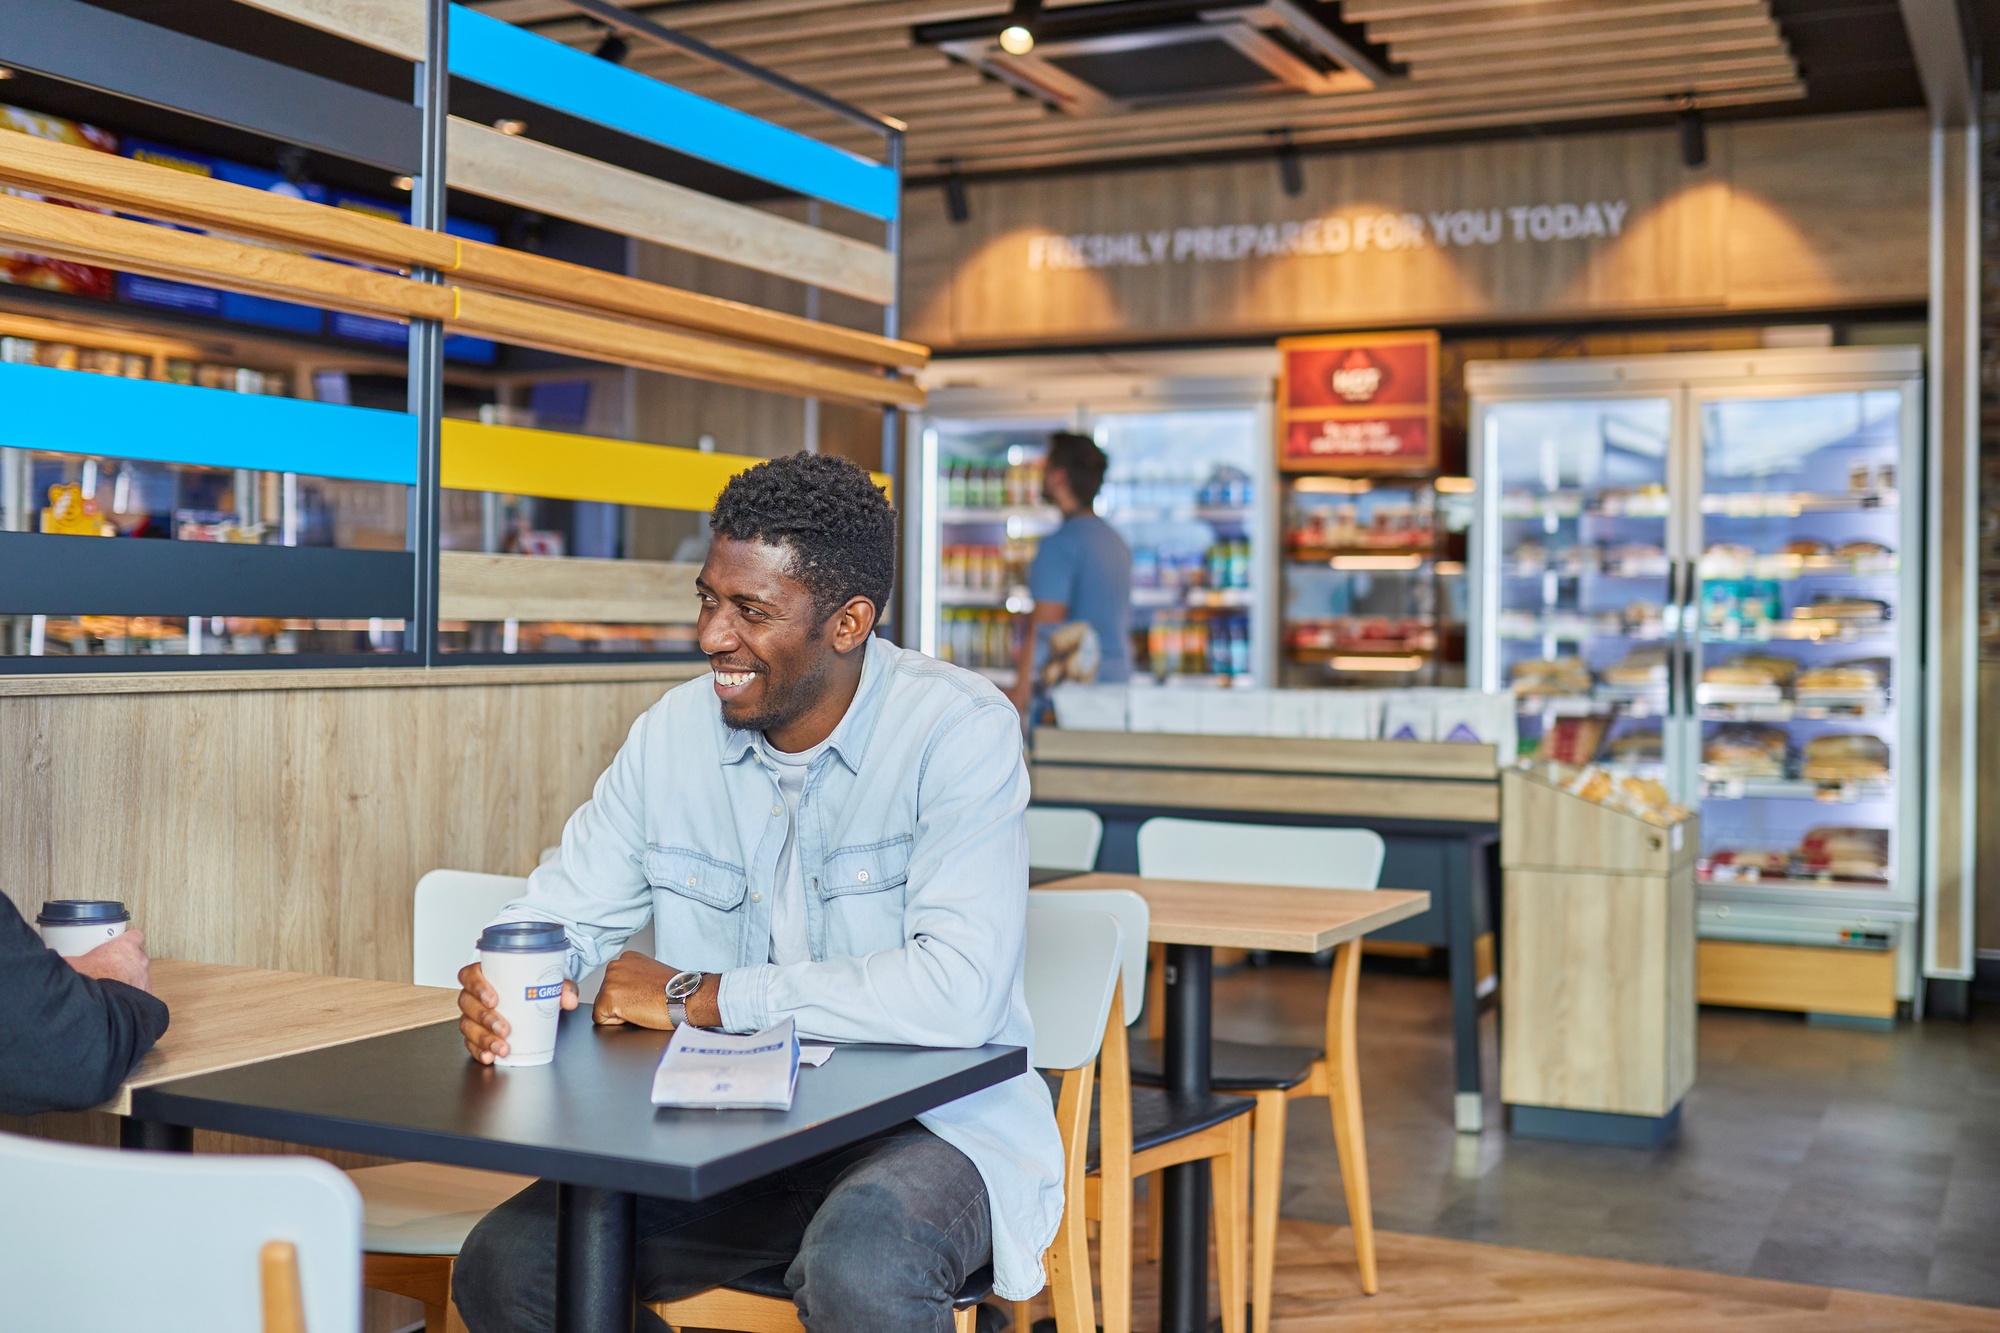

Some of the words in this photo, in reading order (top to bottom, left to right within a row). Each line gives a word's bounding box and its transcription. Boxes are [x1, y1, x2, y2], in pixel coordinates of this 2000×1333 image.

[1028, 231, 1169, 271] FRESHLY
[1173, 217, 1349, 261] PREPARED
[1353, 212, 1425, 253] FOR
[1430, 208, 1500, 247] YOU
[1507, 200, 1627, 242] TODAY
[1332, 367, 1382, 393] HOT
